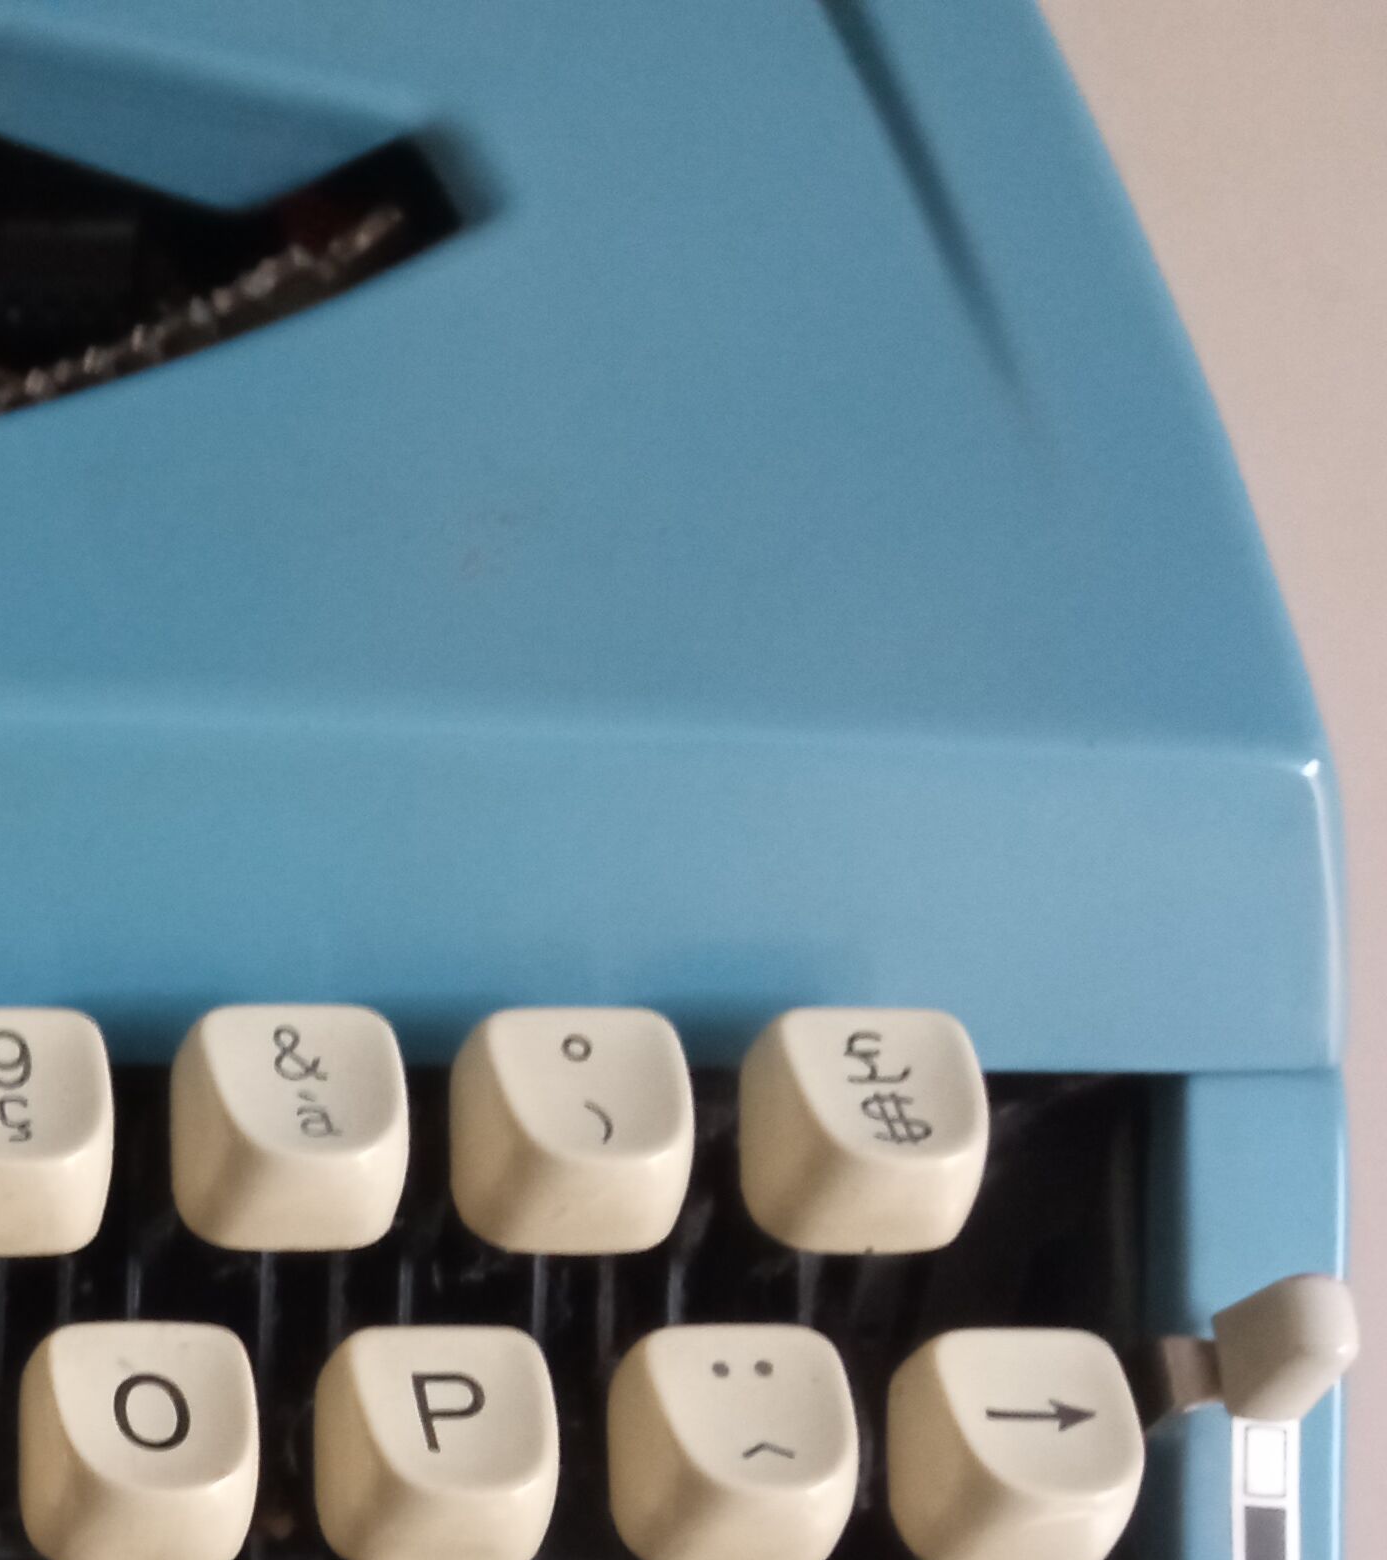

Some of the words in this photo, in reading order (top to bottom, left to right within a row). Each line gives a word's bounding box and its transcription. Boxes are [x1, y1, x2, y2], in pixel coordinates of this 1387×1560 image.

[272, 1024, 328, 1082] &
[843, 1030, 912, 1085] £
[584, 1101, 614, 1145] )
[861, 1091, 934, 1146] $
[113, 1372, 191, 1452] O
[411, 1371, 486, 1453] P
